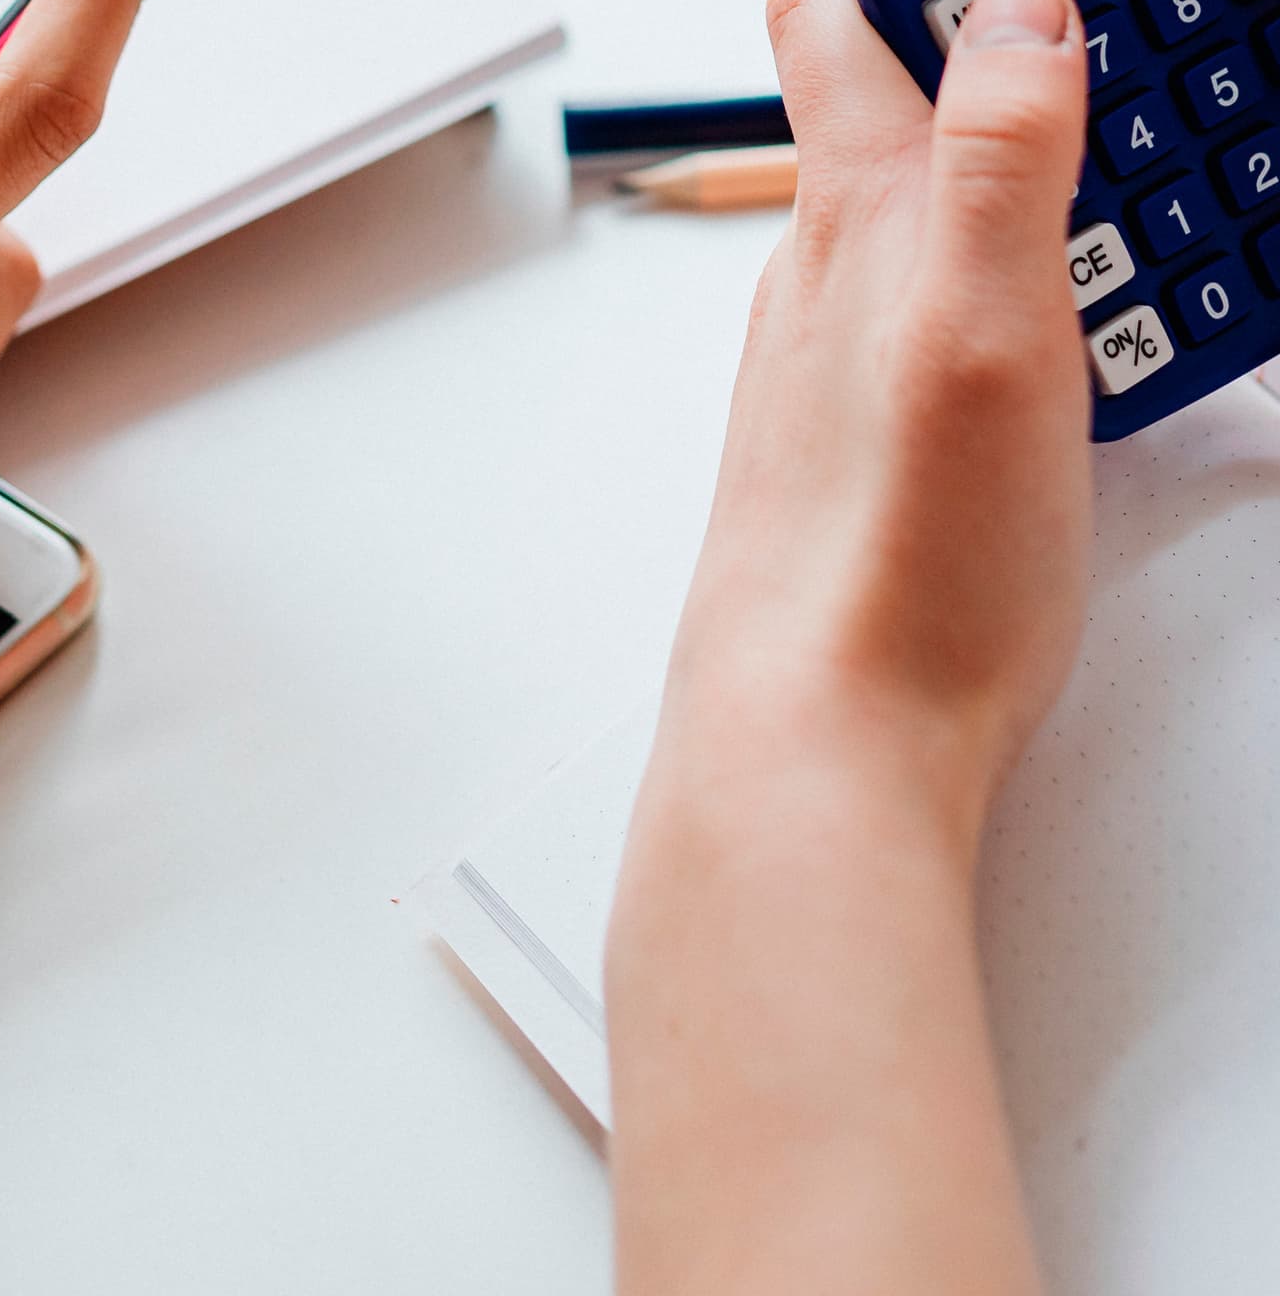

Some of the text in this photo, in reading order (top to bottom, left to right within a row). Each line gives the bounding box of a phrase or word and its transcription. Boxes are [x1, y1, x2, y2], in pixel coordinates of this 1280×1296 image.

[1086, 32, 1109, 73] 7
[1210, 67, 1239, 107] 5
[1130, 115, 1155, 150] 4
[1248, 152, 1279, 193] 2
[1167, 199, 1191, 235] 1
[1069, 243, 1113, 286] CE
[1201, 282, 1230, 320] 0
